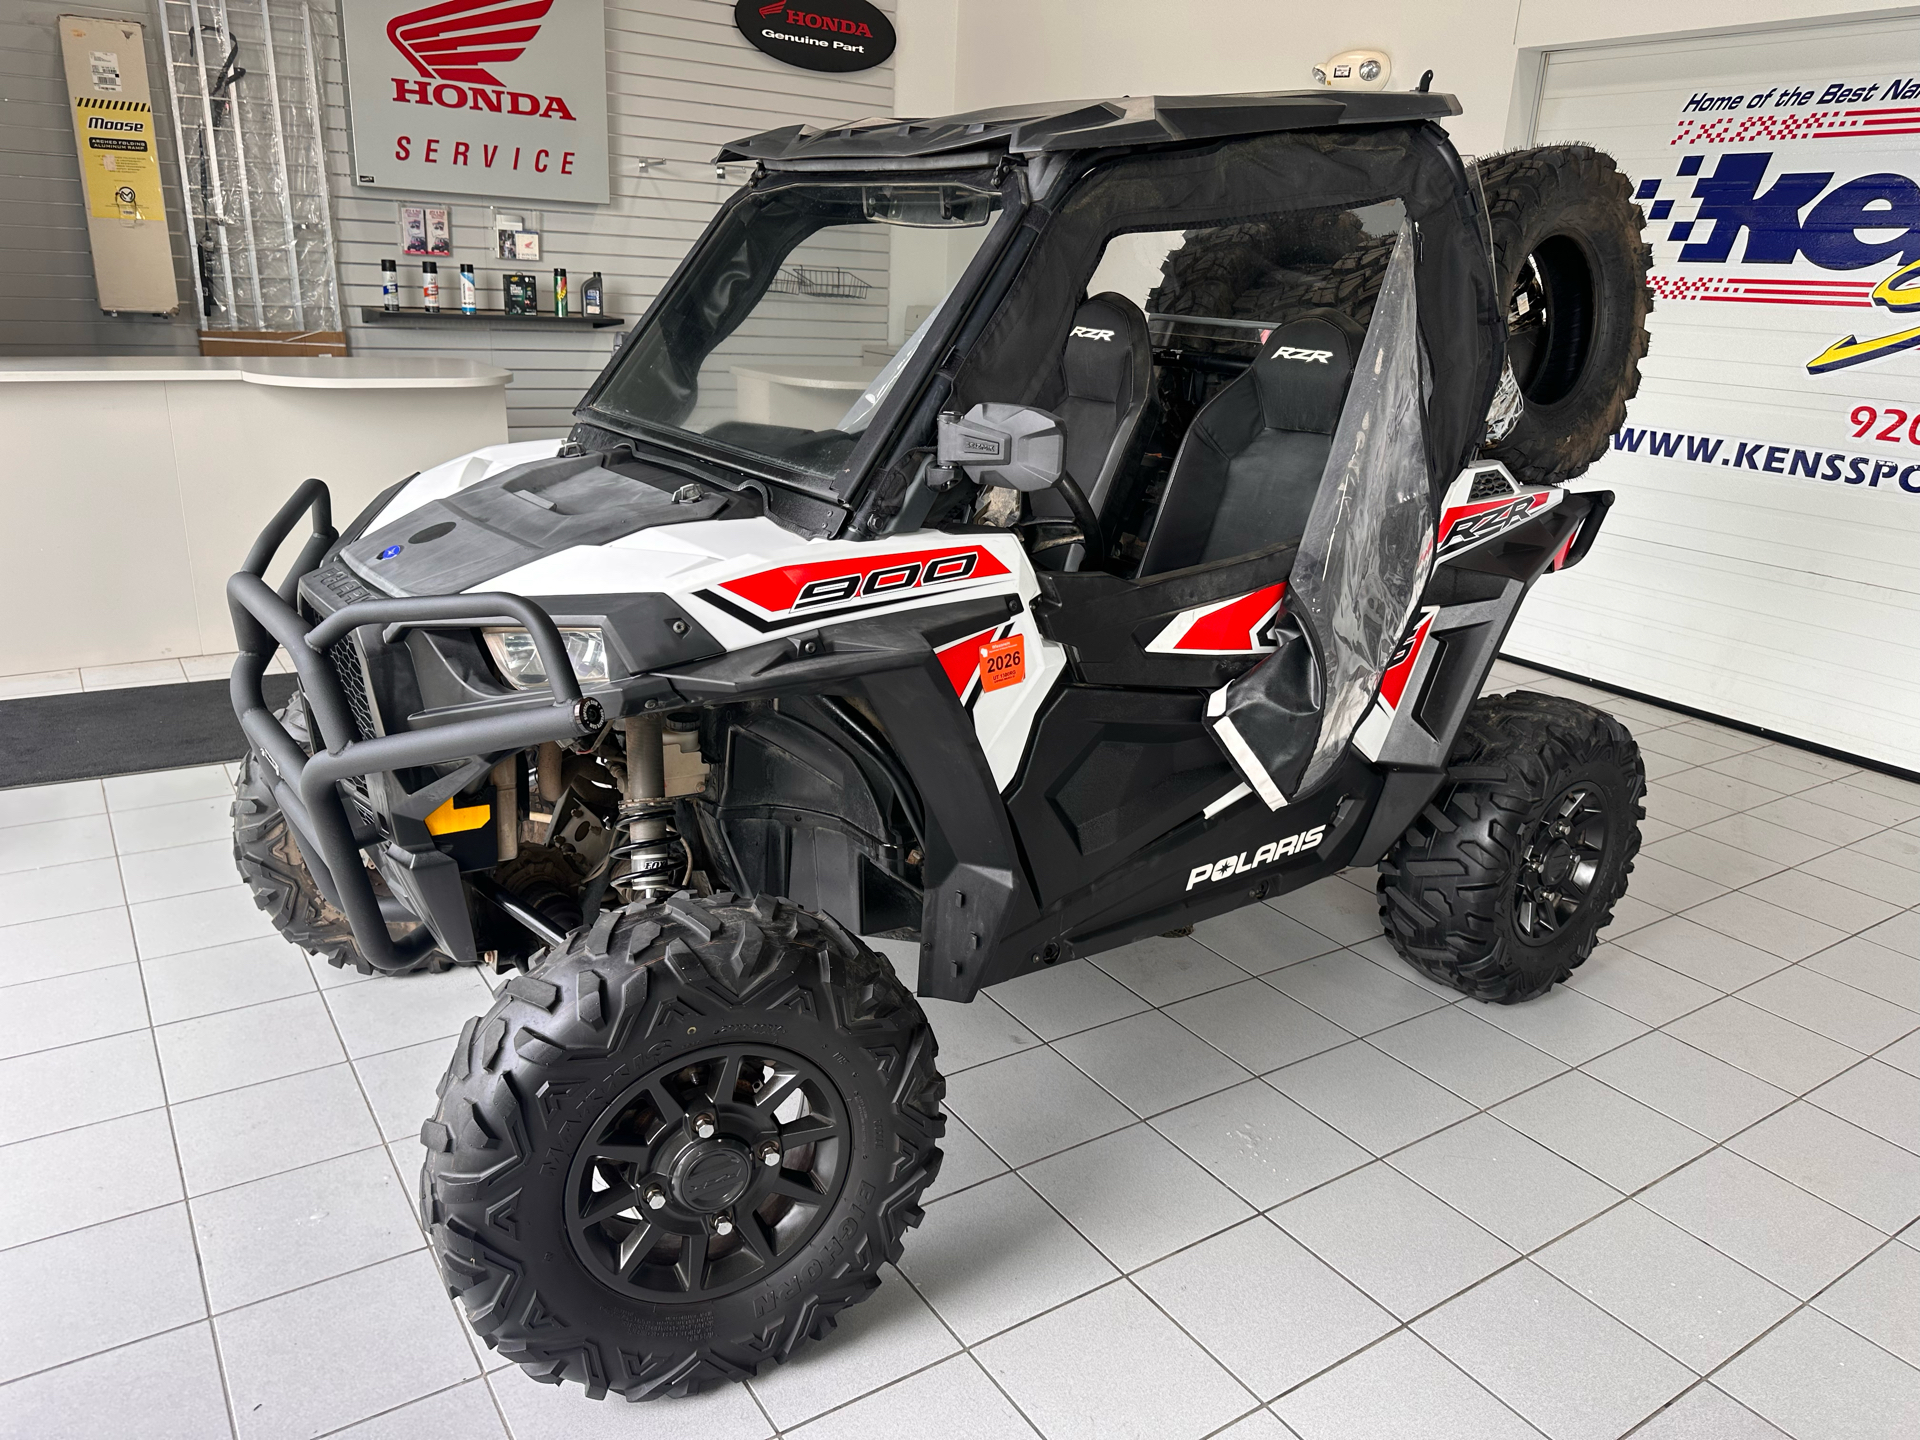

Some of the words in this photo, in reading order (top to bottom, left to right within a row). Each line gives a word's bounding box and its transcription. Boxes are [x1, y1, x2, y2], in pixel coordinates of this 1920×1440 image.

[785, 9, 873, 38] HONDA
[761, 29, 829, 47] Genuine
[833, 40, 865, 54] Part
[391, 77, 577, 121] HONDA
[1682, 92, 1744, 112] Home
[1746, 87, 1778, 109] of
[1776, 86, 1815, 107] the
[1816, 83, 1880, 104] Best
[1880, 78, 1920, 101] Na
[395, 135, 575, 175] SERVICE
[1069, 325, 1115, 342] RZR
[1271, 346, 1334, 364] RZR
[1437, 495, 1536, 552] RZR
[789, 551, 978, 613] 900
[987, 650, 1021, 673] 2026
[1185, 824, 1326, 891] POLARIS
